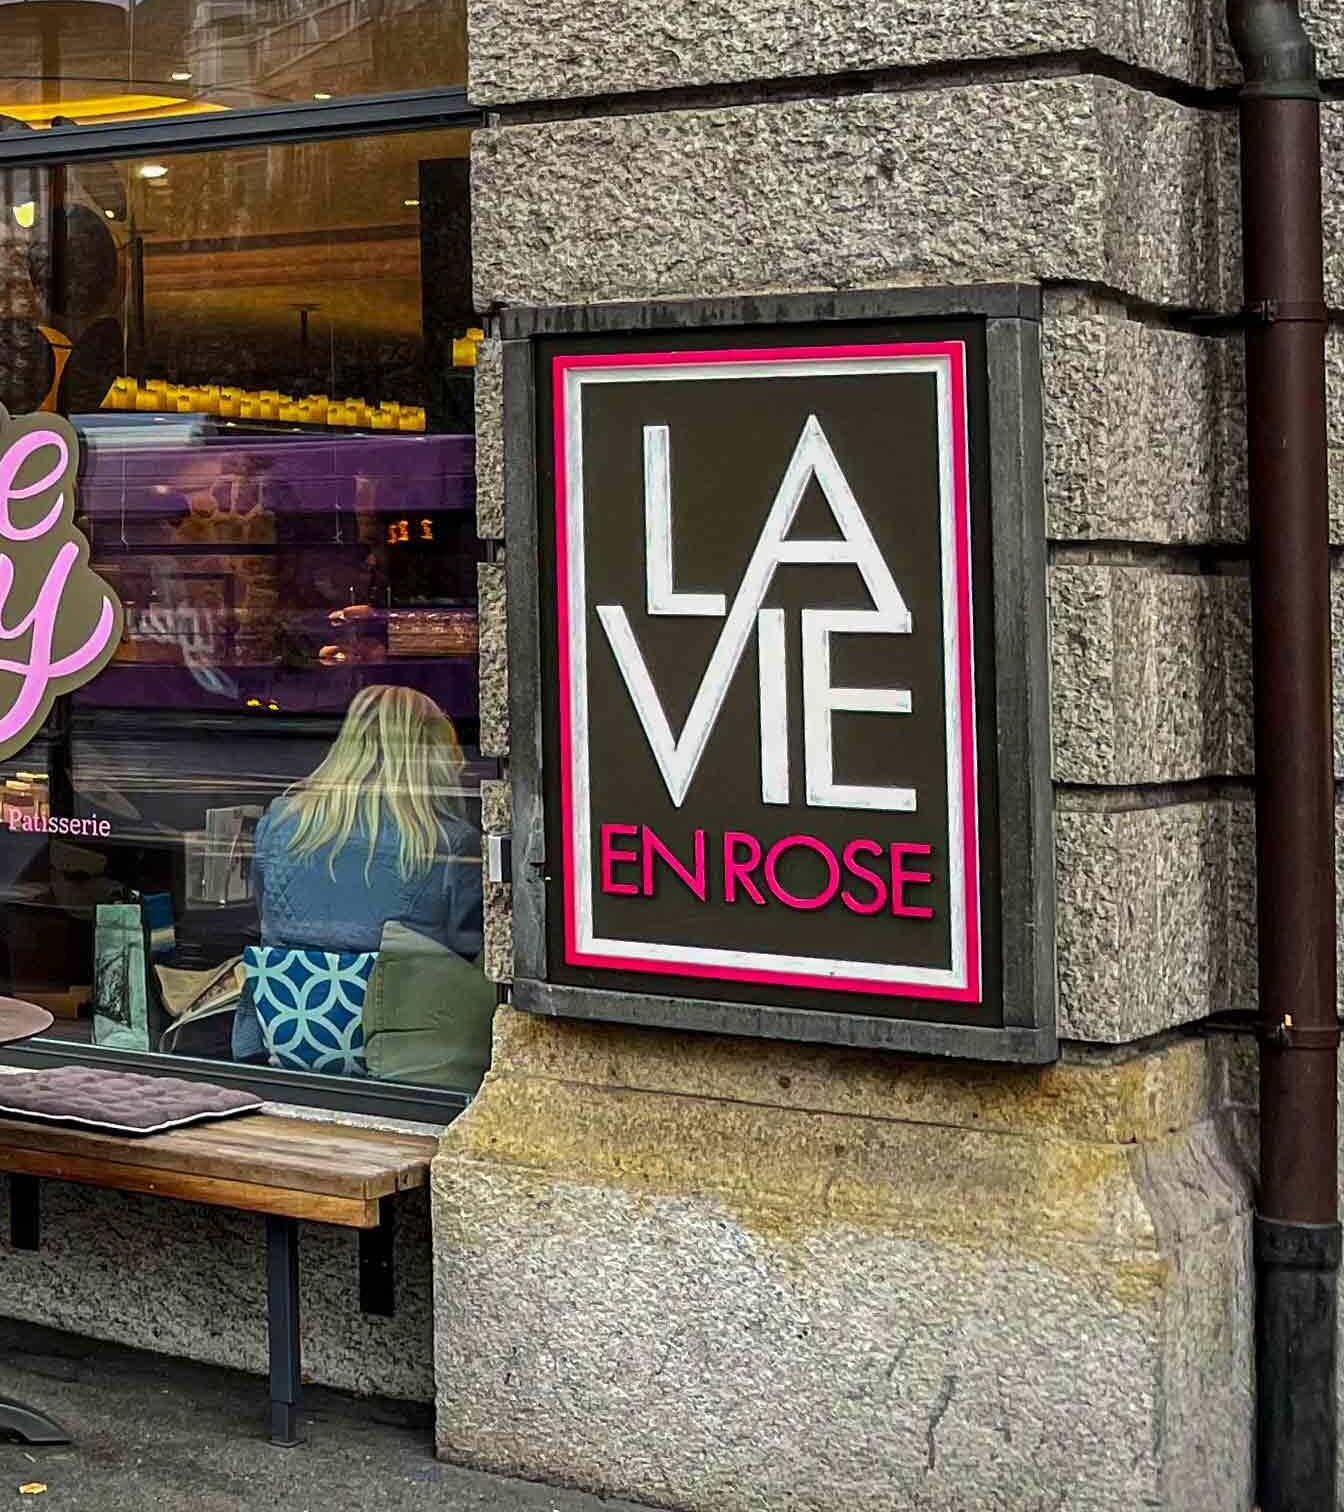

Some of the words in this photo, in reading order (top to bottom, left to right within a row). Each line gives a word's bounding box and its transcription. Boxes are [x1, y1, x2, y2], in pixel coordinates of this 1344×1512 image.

[643, 414, 912, 617] LA
[596, 605, 916, 811] VIE
[9, 808, 111, 838] Patisserie
[600, 823, 706, 903] EN
[723, 831, 934, 919] ROSE
